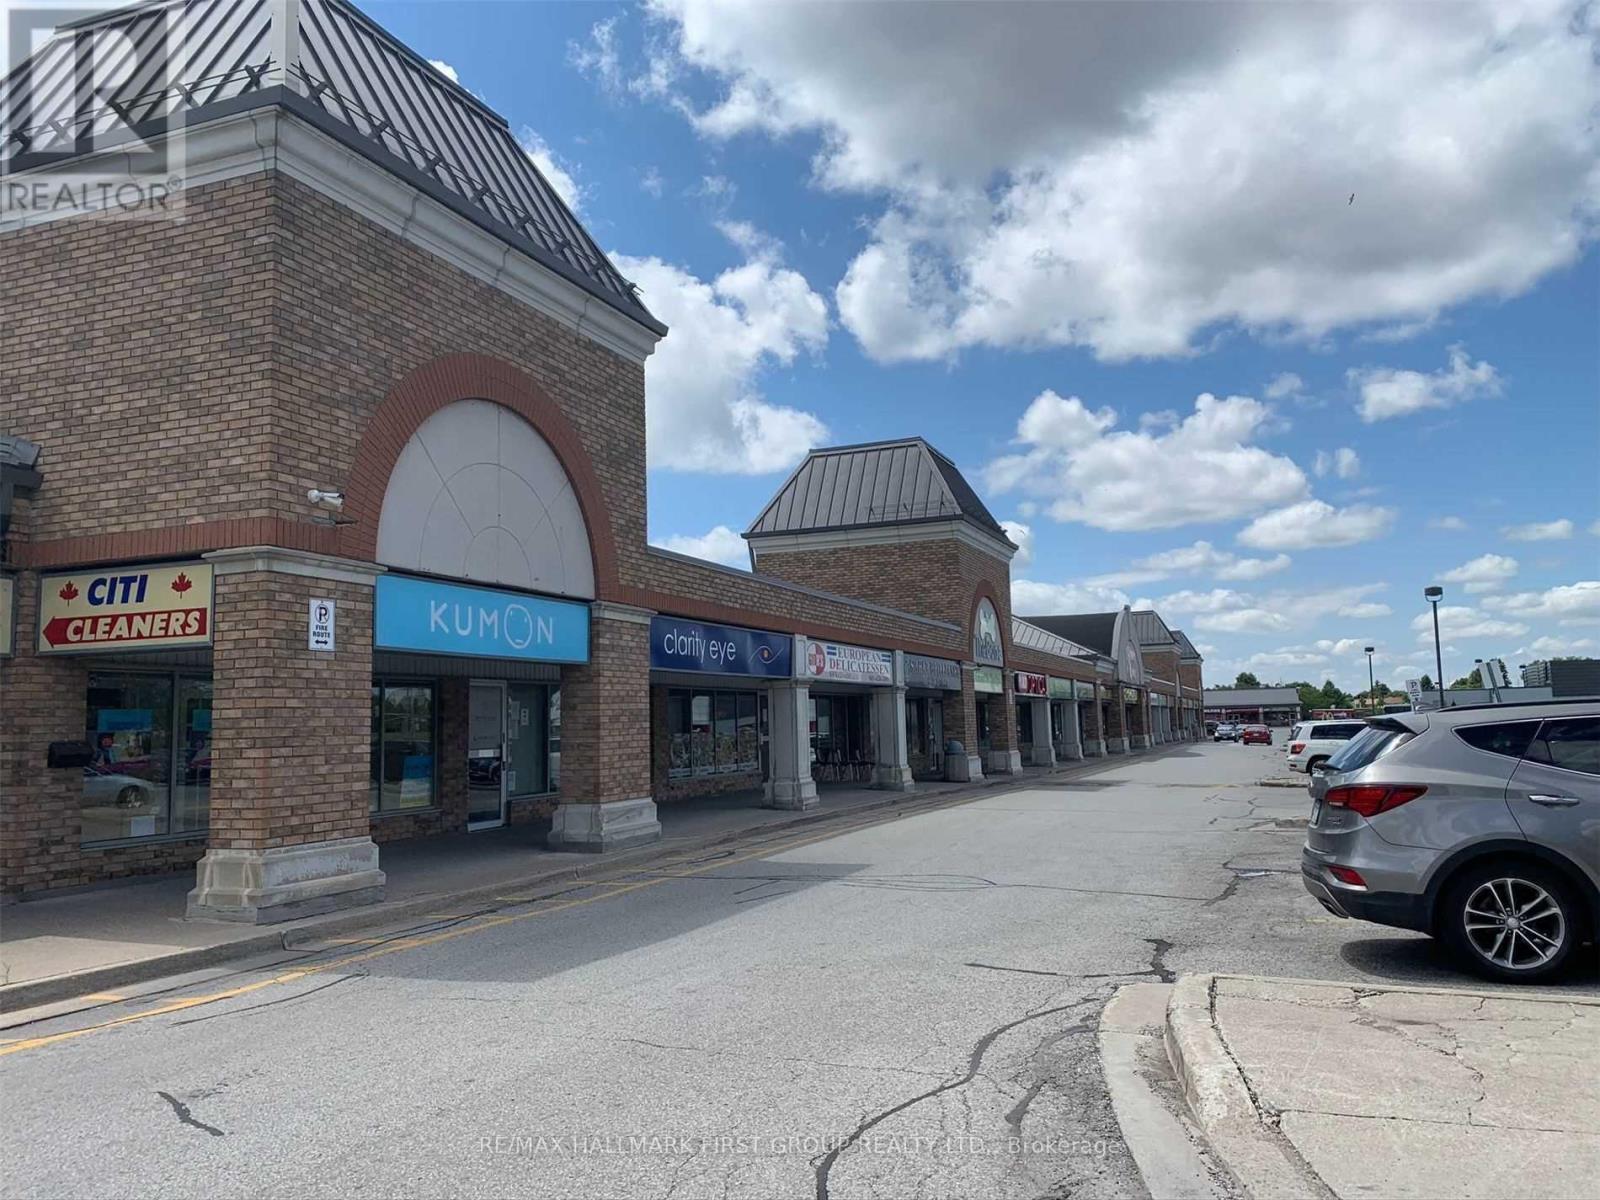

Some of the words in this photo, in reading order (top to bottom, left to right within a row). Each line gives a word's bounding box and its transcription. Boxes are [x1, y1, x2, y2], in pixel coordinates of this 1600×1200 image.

[87, 574, 149, 607] CITI
[66, 611, 200, 642] CLEANERS
[430, 600, 553, 649] KUMON
[663, 628, 706, 664] clarity
[709, 640, 736, 665] eye
[837, 647, 881, 663] EUROPEAN
[829, 658, 889, 674] DELICATESSEN
